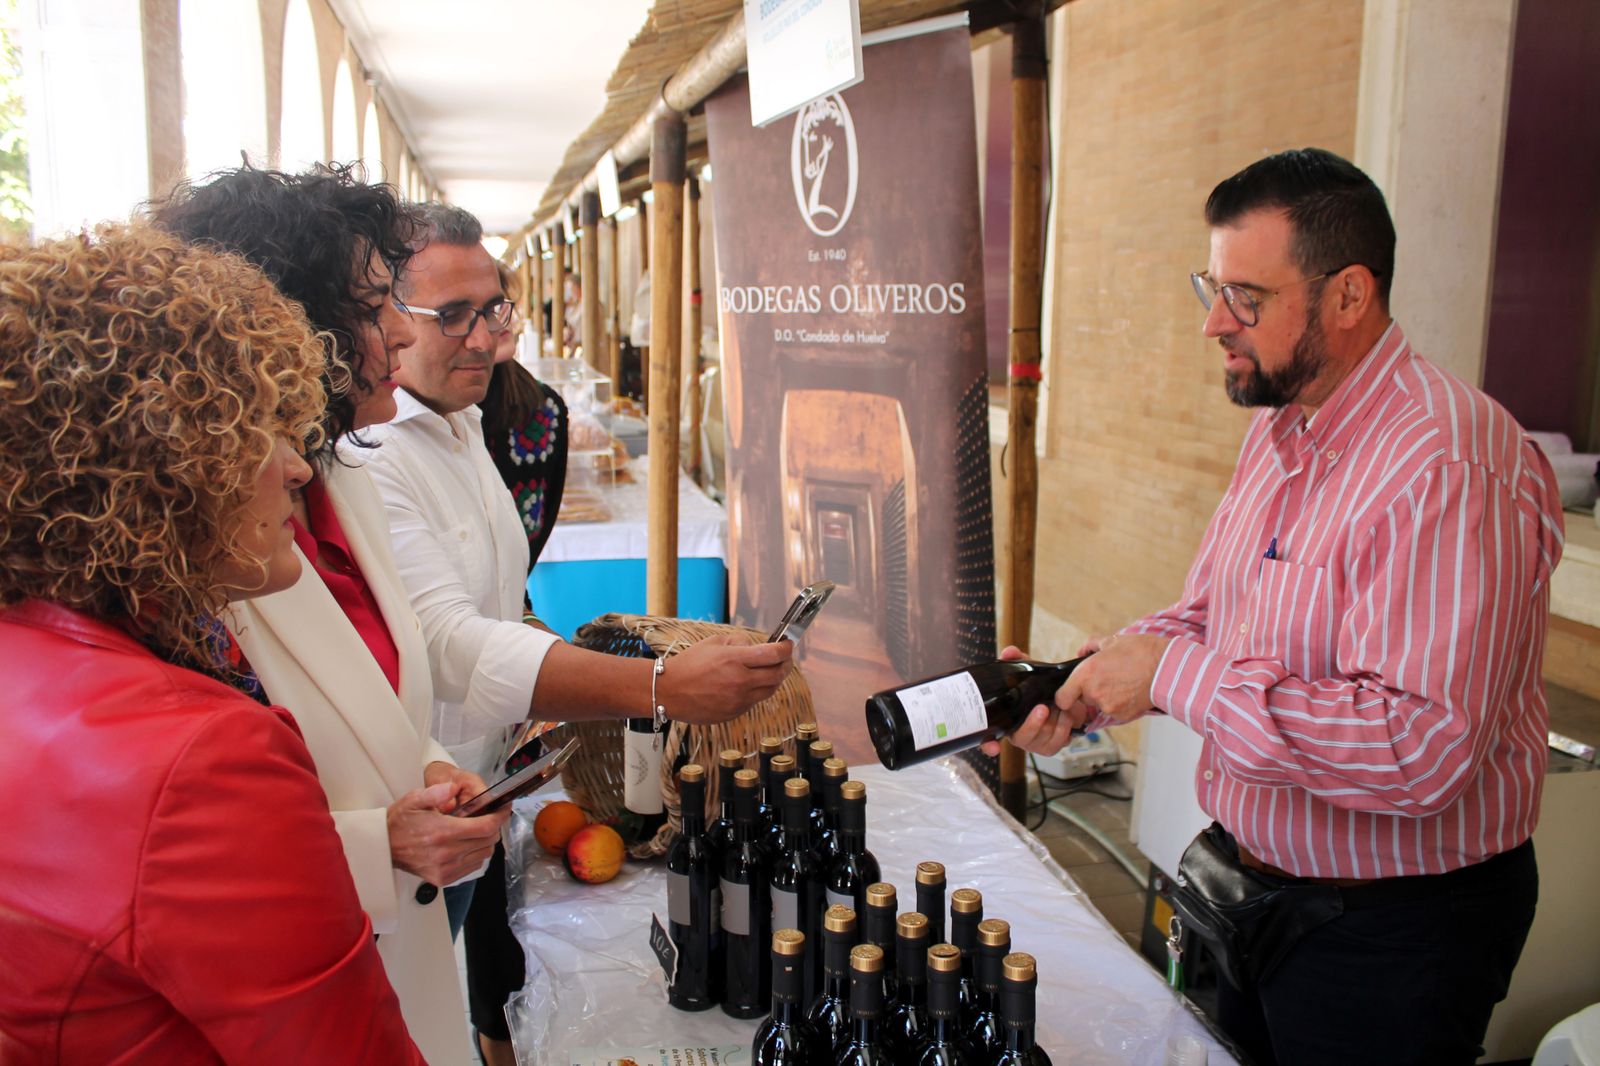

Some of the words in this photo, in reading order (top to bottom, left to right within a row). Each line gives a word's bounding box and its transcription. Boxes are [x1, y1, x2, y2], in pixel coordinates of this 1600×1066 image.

[808, 249, 822, 262] Est.
[824, 248, 847, 261] 1940
[721, 284, 822, 314] BODEGAS
[829, 282, 967, 314] OLIVEROS
[774, 329, 795, 342] D.O.
[842, 330, 855, 343] de
[653, 927, 670, 959] 10€
